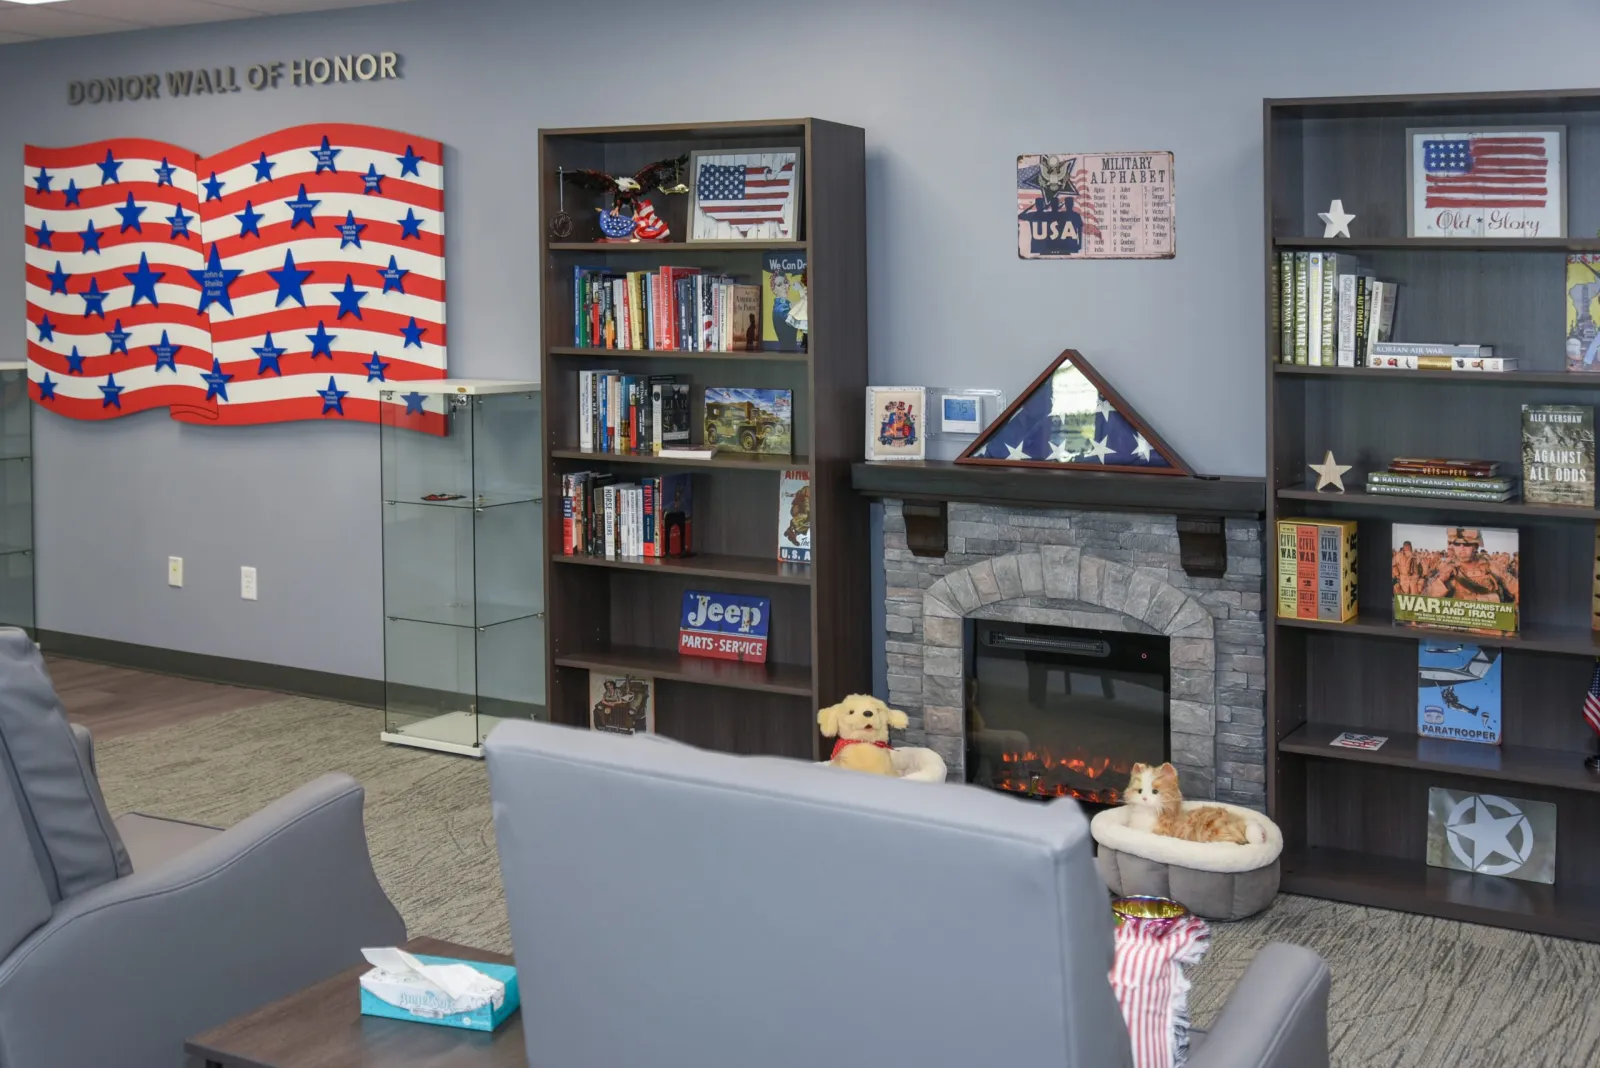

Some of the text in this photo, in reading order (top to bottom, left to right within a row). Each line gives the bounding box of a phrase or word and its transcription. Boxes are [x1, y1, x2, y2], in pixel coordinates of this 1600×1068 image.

[67, 51, 398, 105] DONOR WALL OF HONOR
[1101, 156, 1152, 171] MILITARY
[1090, 170, 1166, 185] ALPHABET
[1436, 209, 1541, 236] Old Glory
[1032, 221, 1079, 241] USA
[769, 258, 781, 270] We
[782, 258, 796, 270] Can
[203, 271, 219, 279] John
[204, 280, 223, 288] Sheila
[1297, 275, 1306, 346] VIETNAM WAR
[1322, 275, 1332, 346] VIETNAM WAR
[1356, 295, 1364, 337] AUTOMATIC
[1376, 346, 1408, 354] KOREAN
[1530, 414, 1582, 424] ALEX KERSHAW
[1534, 450, 1582, 465] AGAINST
[1423, 467, 1440, 475] VETS
[1449, 468, 1467, 476] PETS
[1530, 467, 1586, 482] ALL ODDS
[643, 485, 652, 515] CRUSADE
[1280, 534, 1296, 548] CIVIL
[1299, 537, 1316, 550] CIVIL
[1320, 537, 1338, 550] CIVIL
[1280, 548, 1296, 560] WAR
[1299, 552, 1316, 562] WAR
[1321, 551, 1338, 562] WAR
[1281, 588, 1296, 597] SHELBY
[1299, 592, 1316, 600] SHELBY
[1321, 592, 1337, 600] SHELBY
[1397, 594, 1512, 614] WAR IN AFGHANISTAN
[1442, 608, 1465, 616] AND
[1468, 609, 1496, 620] IRAQ
[682, 634, 762, 657] PARTS SERVICE
[1422, 724, 1496, 741] PARATROOPER
